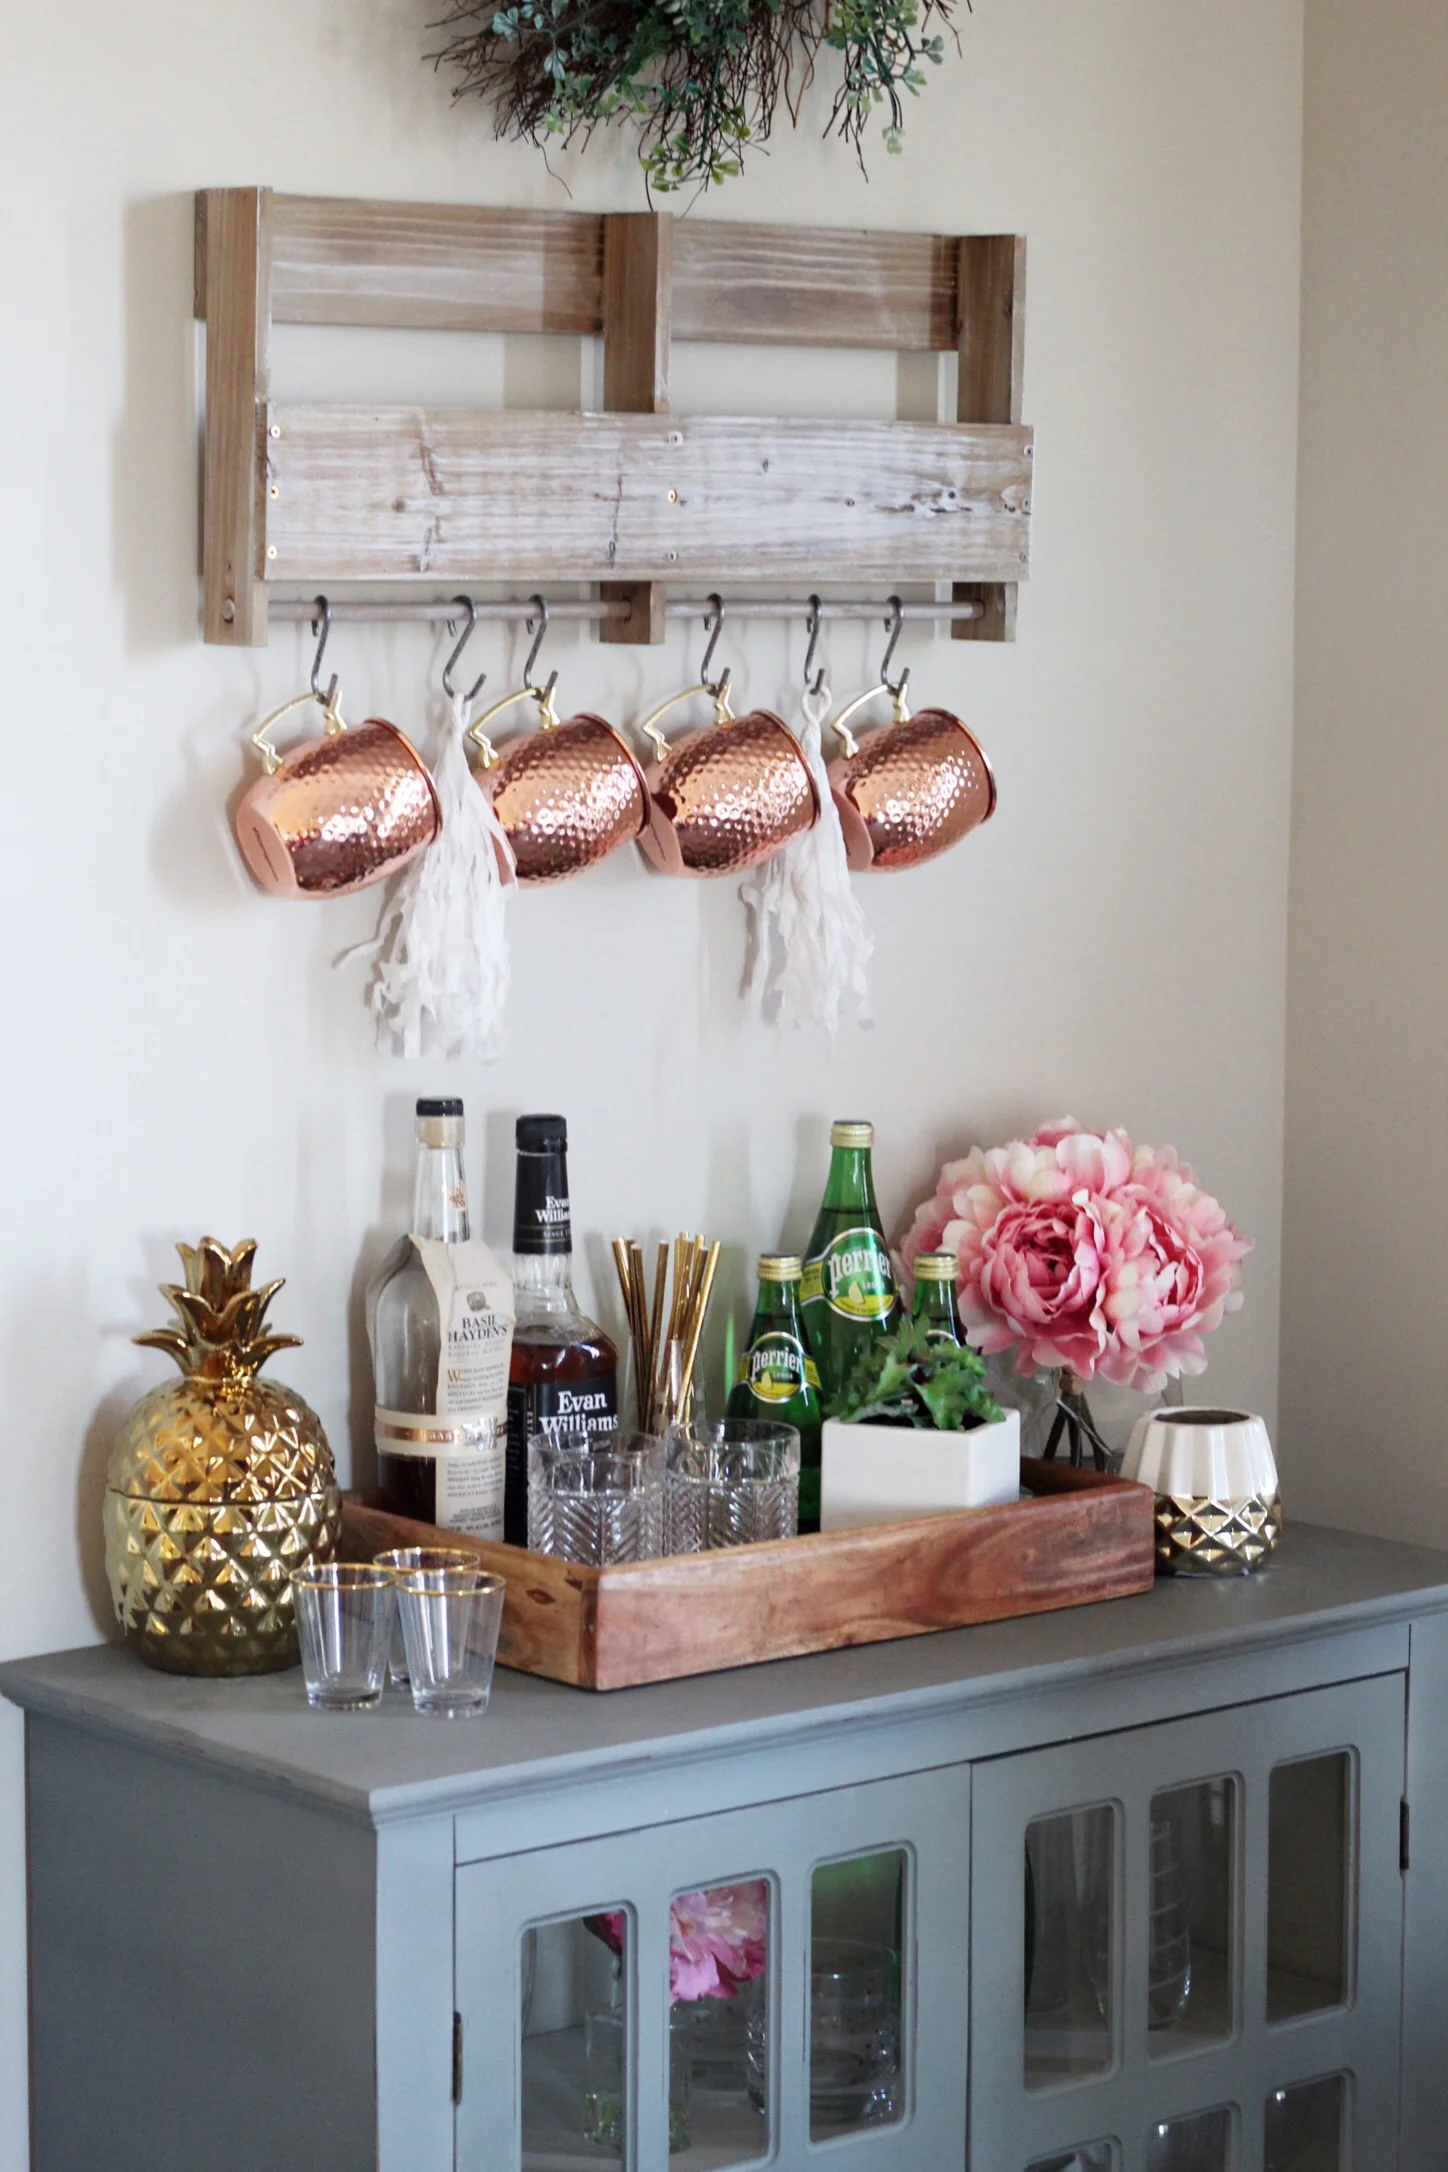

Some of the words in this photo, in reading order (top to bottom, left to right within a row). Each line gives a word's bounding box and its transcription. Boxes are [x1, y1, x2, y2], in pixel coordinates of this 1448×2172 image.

[462, 1313, 496, 1329] BASIL
[447, 1322, 508, 1342] HAYDEN'S
[557, 1390, 607, 1415] Evan
[538, 1413, 619, 1436] Williams
